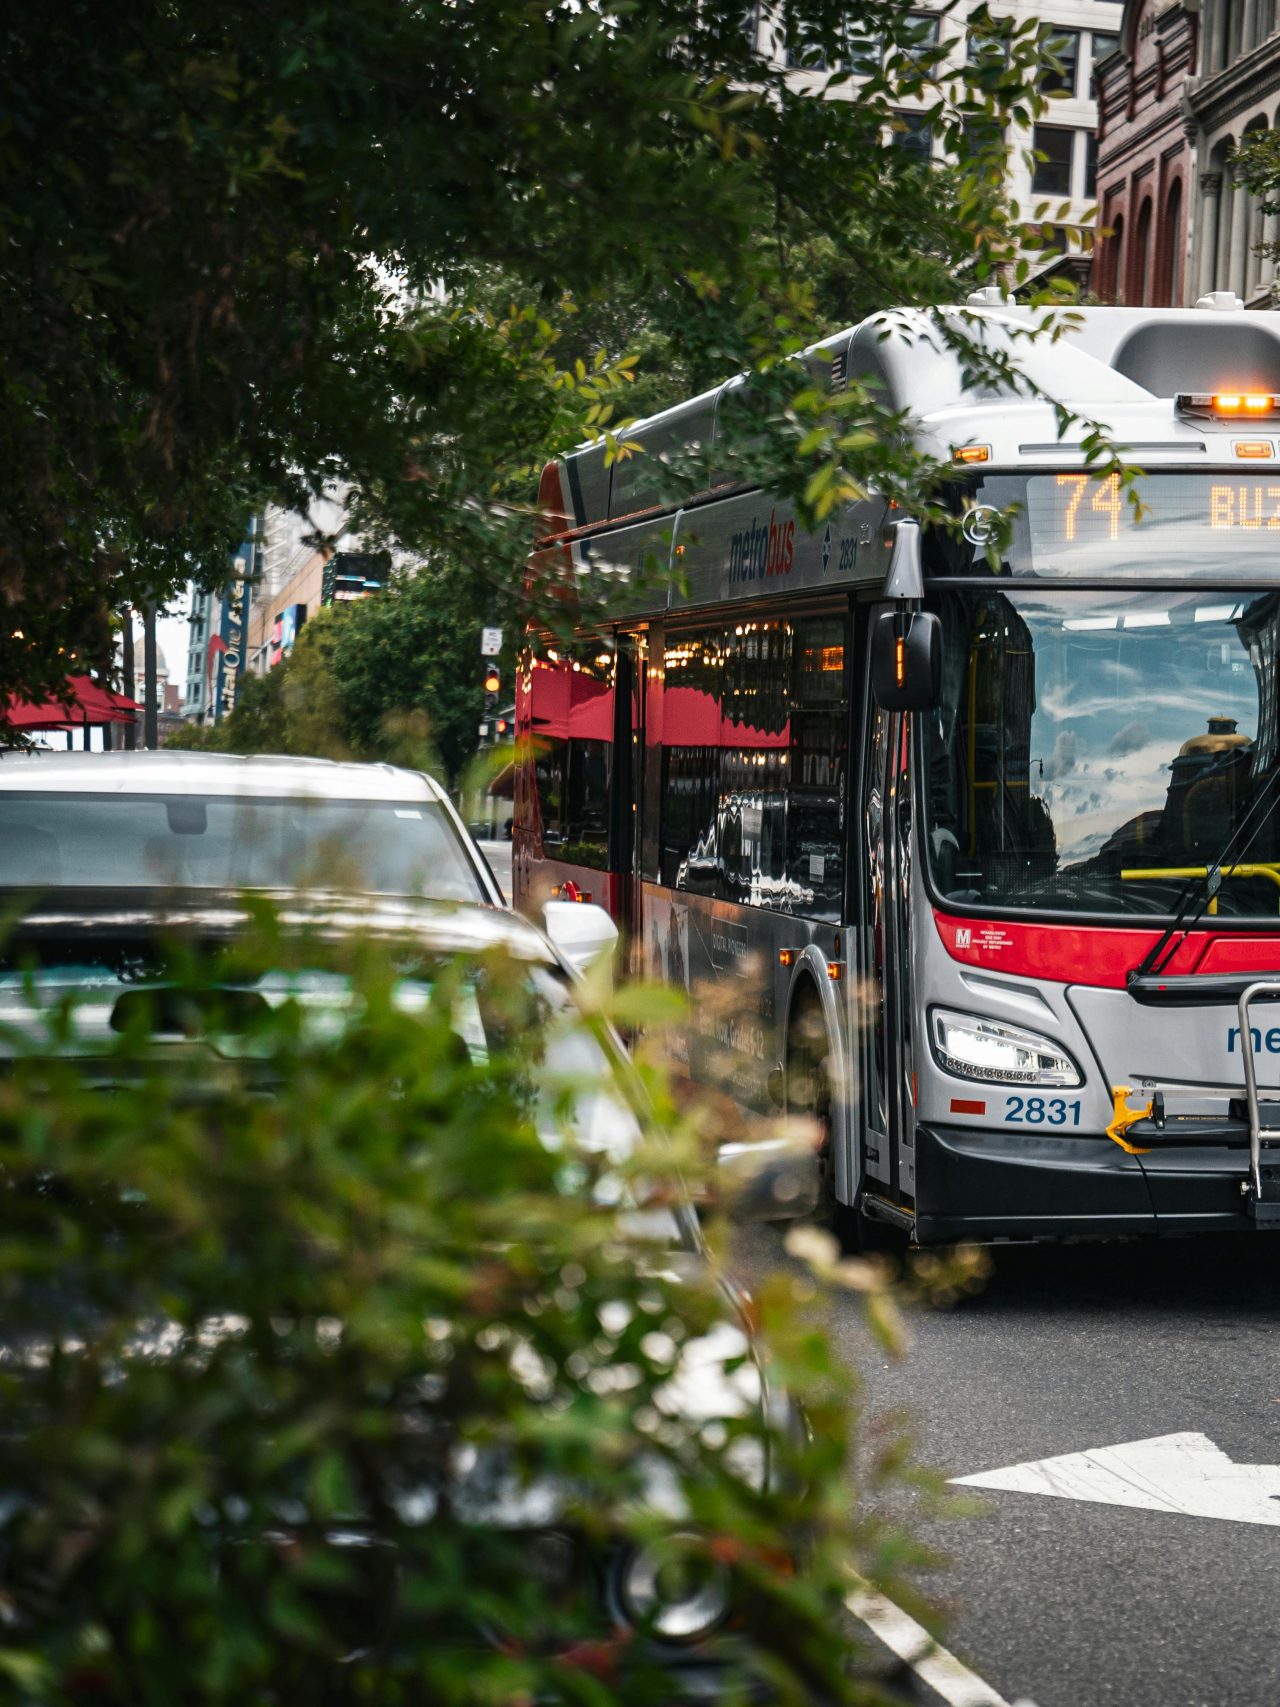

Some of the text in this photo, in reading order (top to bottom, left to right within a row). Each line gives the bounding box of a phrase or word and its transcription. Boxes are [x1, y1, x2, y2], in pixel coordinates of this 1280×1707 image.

[1056, 473, 1121, 540] 74
[728, 506, 795, 584] metrobus
[838, 537, 858, 571] 2831
[956, 928, 971, 944] M
[1005, 1095, 1082, 1126] 2831
